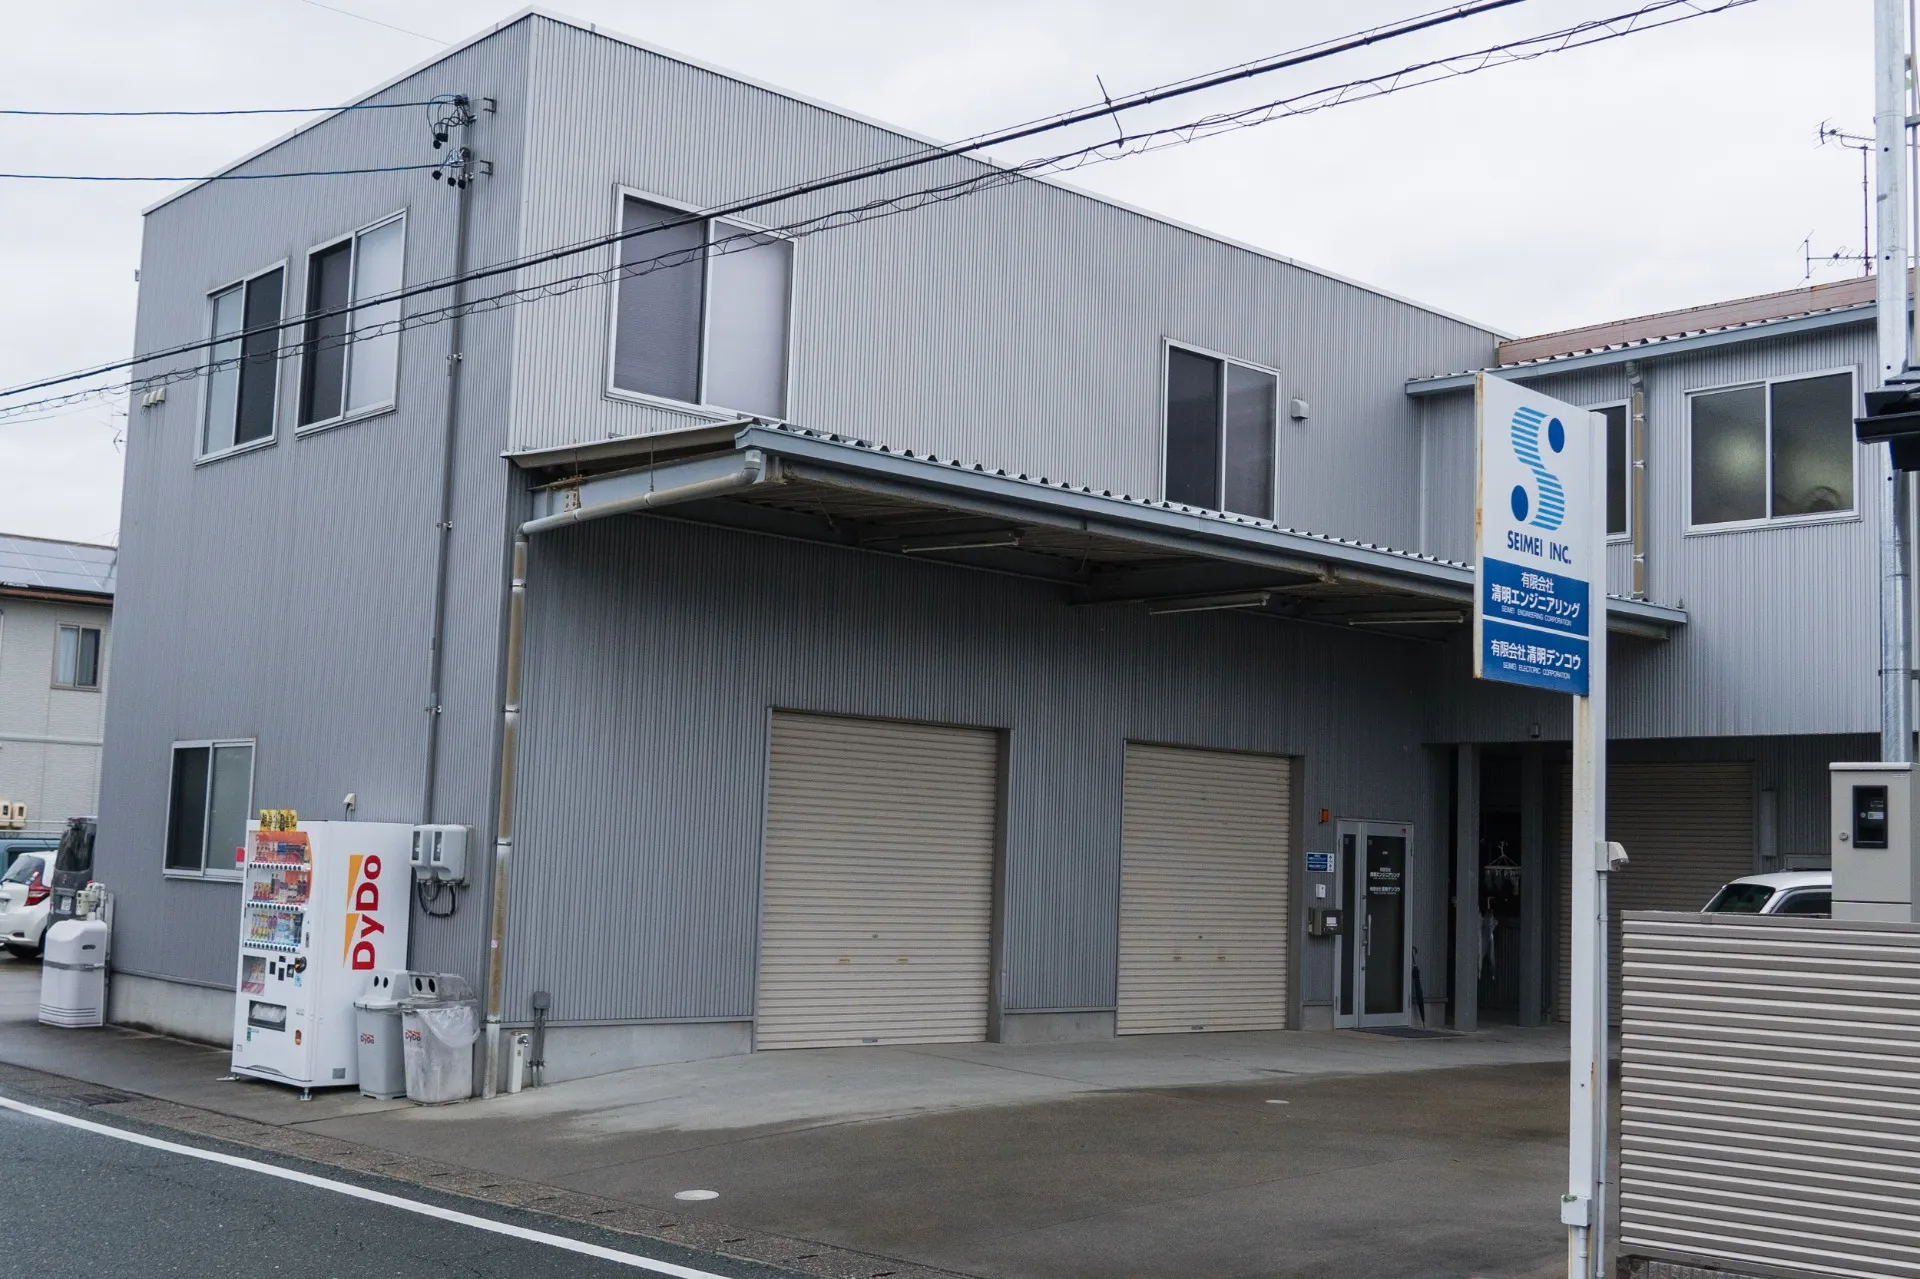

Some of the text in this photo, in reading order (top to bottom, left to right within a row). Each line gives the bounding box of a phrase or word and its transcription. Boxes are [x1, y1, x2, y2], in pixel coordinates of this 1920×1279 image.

[1507, 529, 1572, 564] SEIMEI INC.
[1521, 571, 1555, 594] 有限会社
[1491, 583, 1580, 618] 清明エンジニアリング
[1545, 614, 1572, 627] CORPORATION
[352, 854, 385, 970] DyDo
[405, 1031, 421, 1042] DyDo
